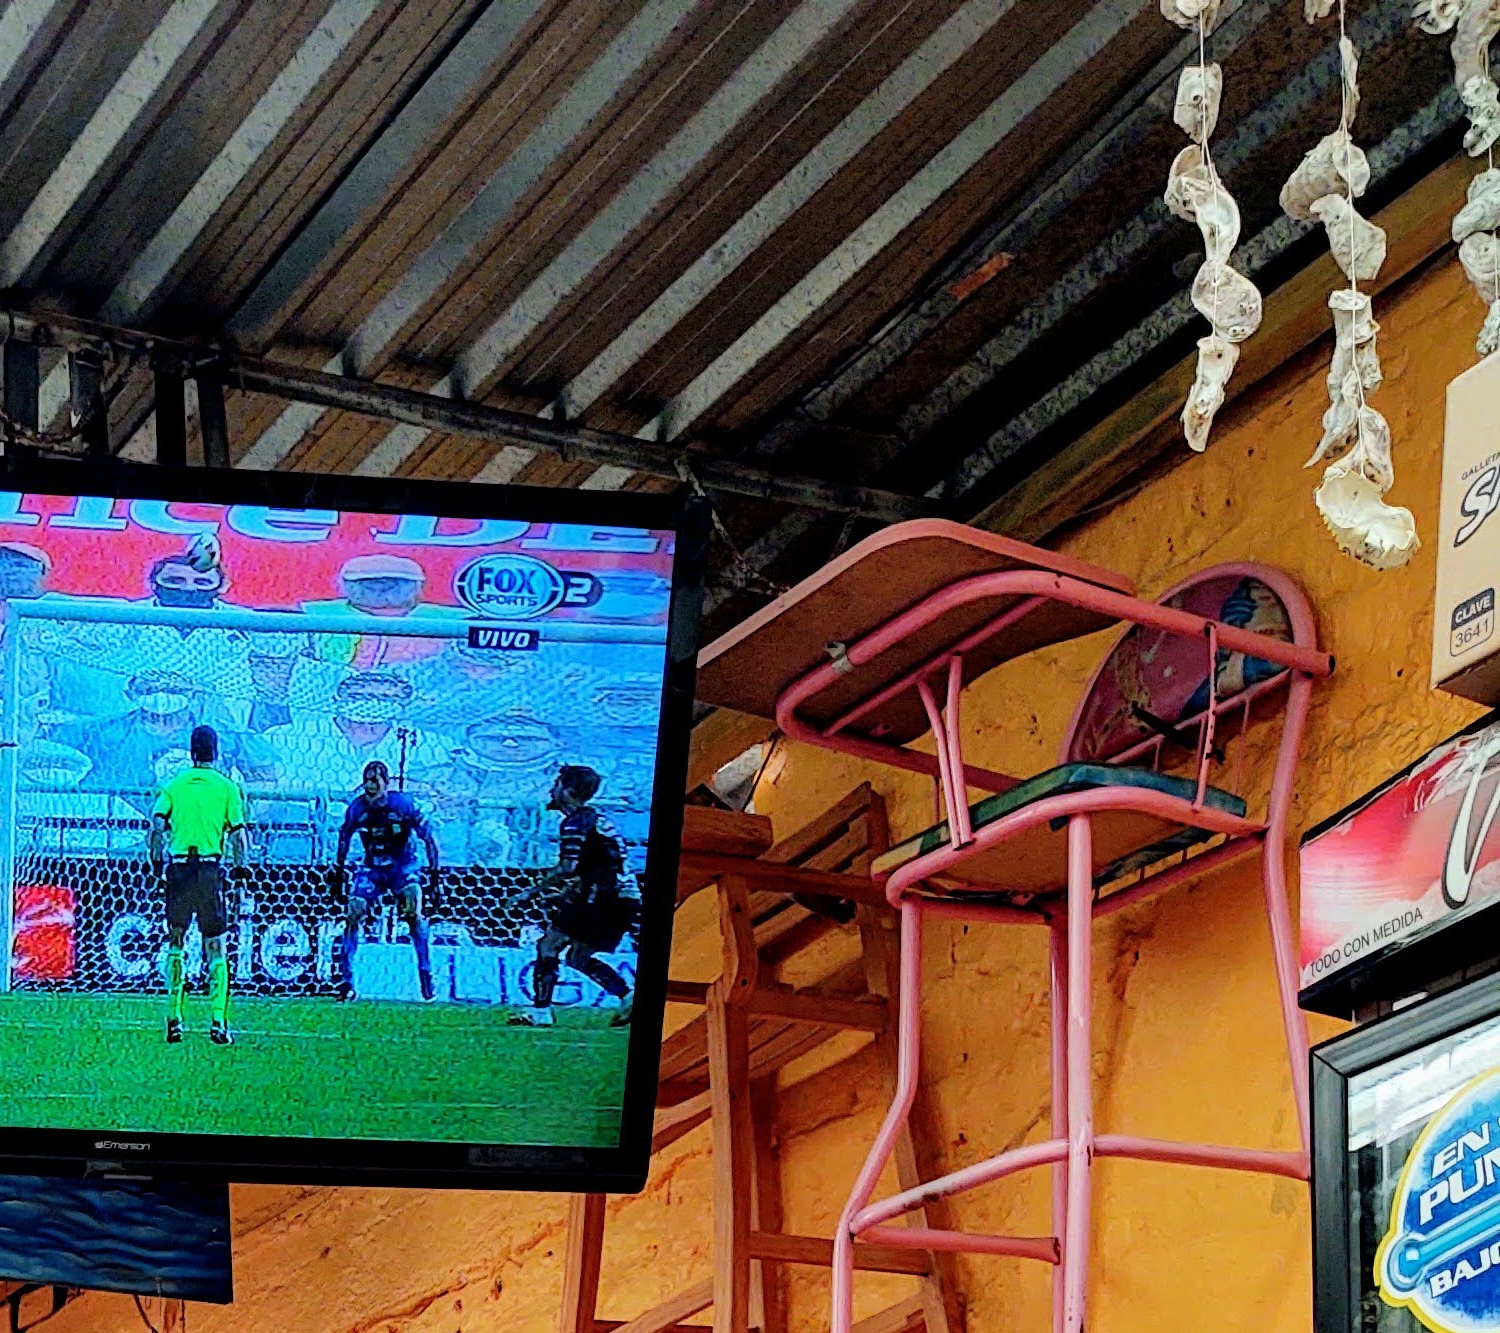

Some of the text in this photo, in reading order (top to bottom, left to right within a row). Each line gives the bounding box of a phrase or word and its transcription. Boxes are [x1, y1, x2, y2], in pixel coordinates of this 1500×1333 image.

[476, 593, 538, 607] SPORTS
[477, 566, 593, 604] FOX 2
[1455, 594, 1492, 624] CLAVE
[478, 629, 532, 649] VIVO
[1455, 618, 1488, 648] 3641
[1310, 906, 1423, 977] TODO CON MEDIDA
[1431, 1121, 1491, 1179] EN
